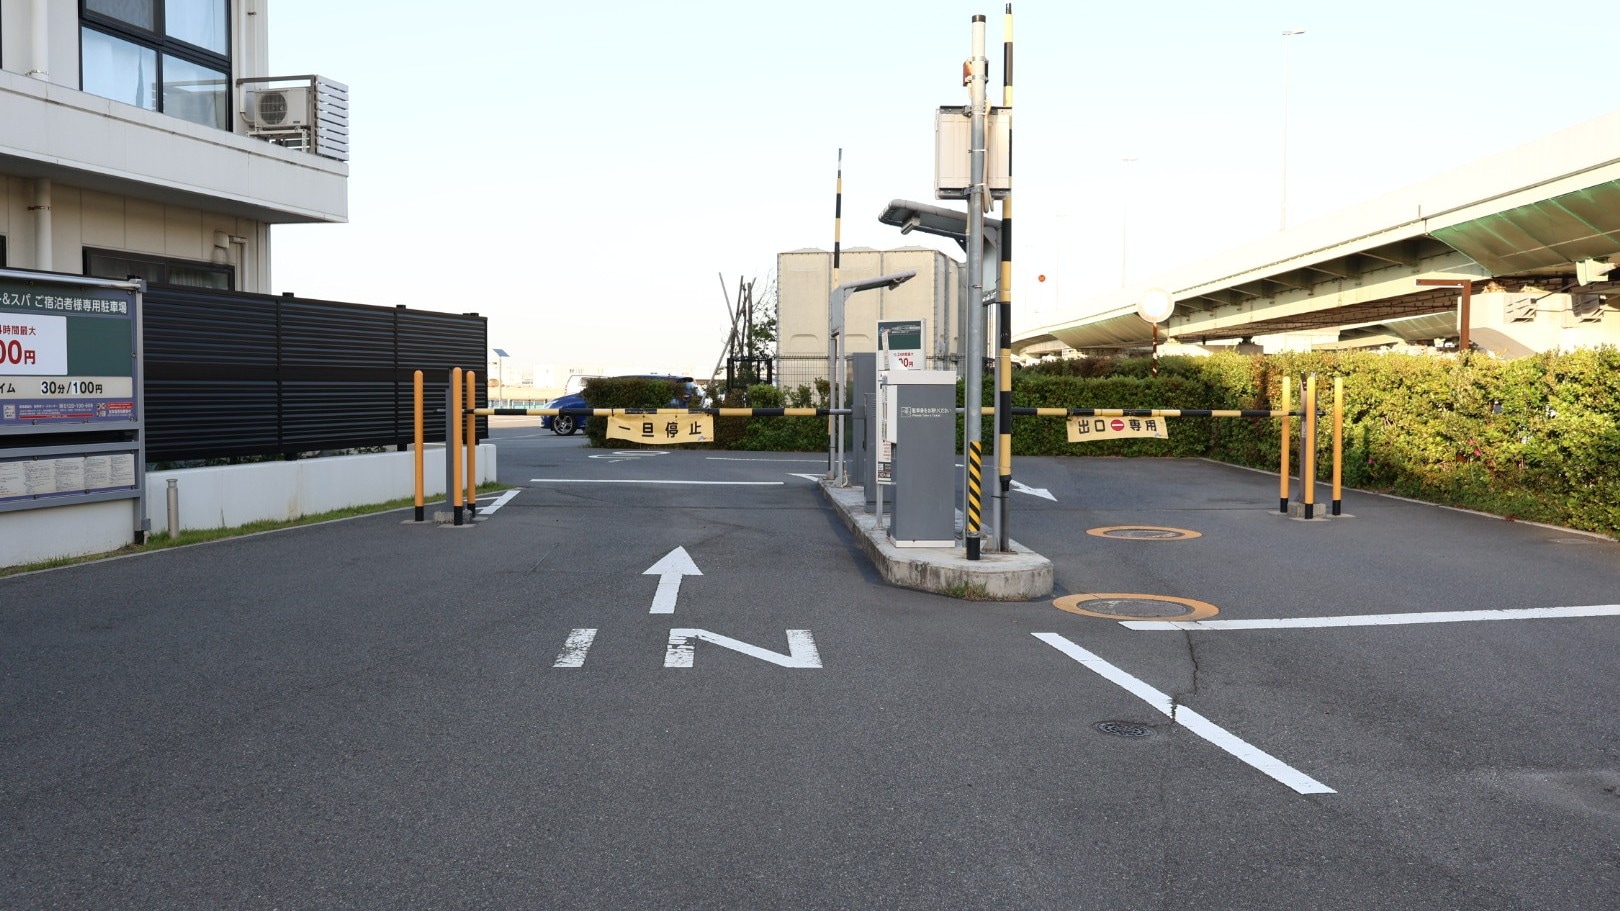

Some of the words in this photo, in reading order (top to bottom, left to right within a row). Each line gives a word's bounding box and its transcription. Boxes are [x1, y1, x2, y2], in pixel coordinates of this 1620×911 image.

[0, 292, 31, 307] &スパ
[35, 295, 127, 314] ご宿泊者様専用駐車場
[41, 381, 103, 394] 30分/100円
[618, 421, 702, 438] 一旦停止
[1078, 419, 1106, 434] 出口
[1128, 419, 1157, 432] 専用
[553, 628, 823, 669] IN
